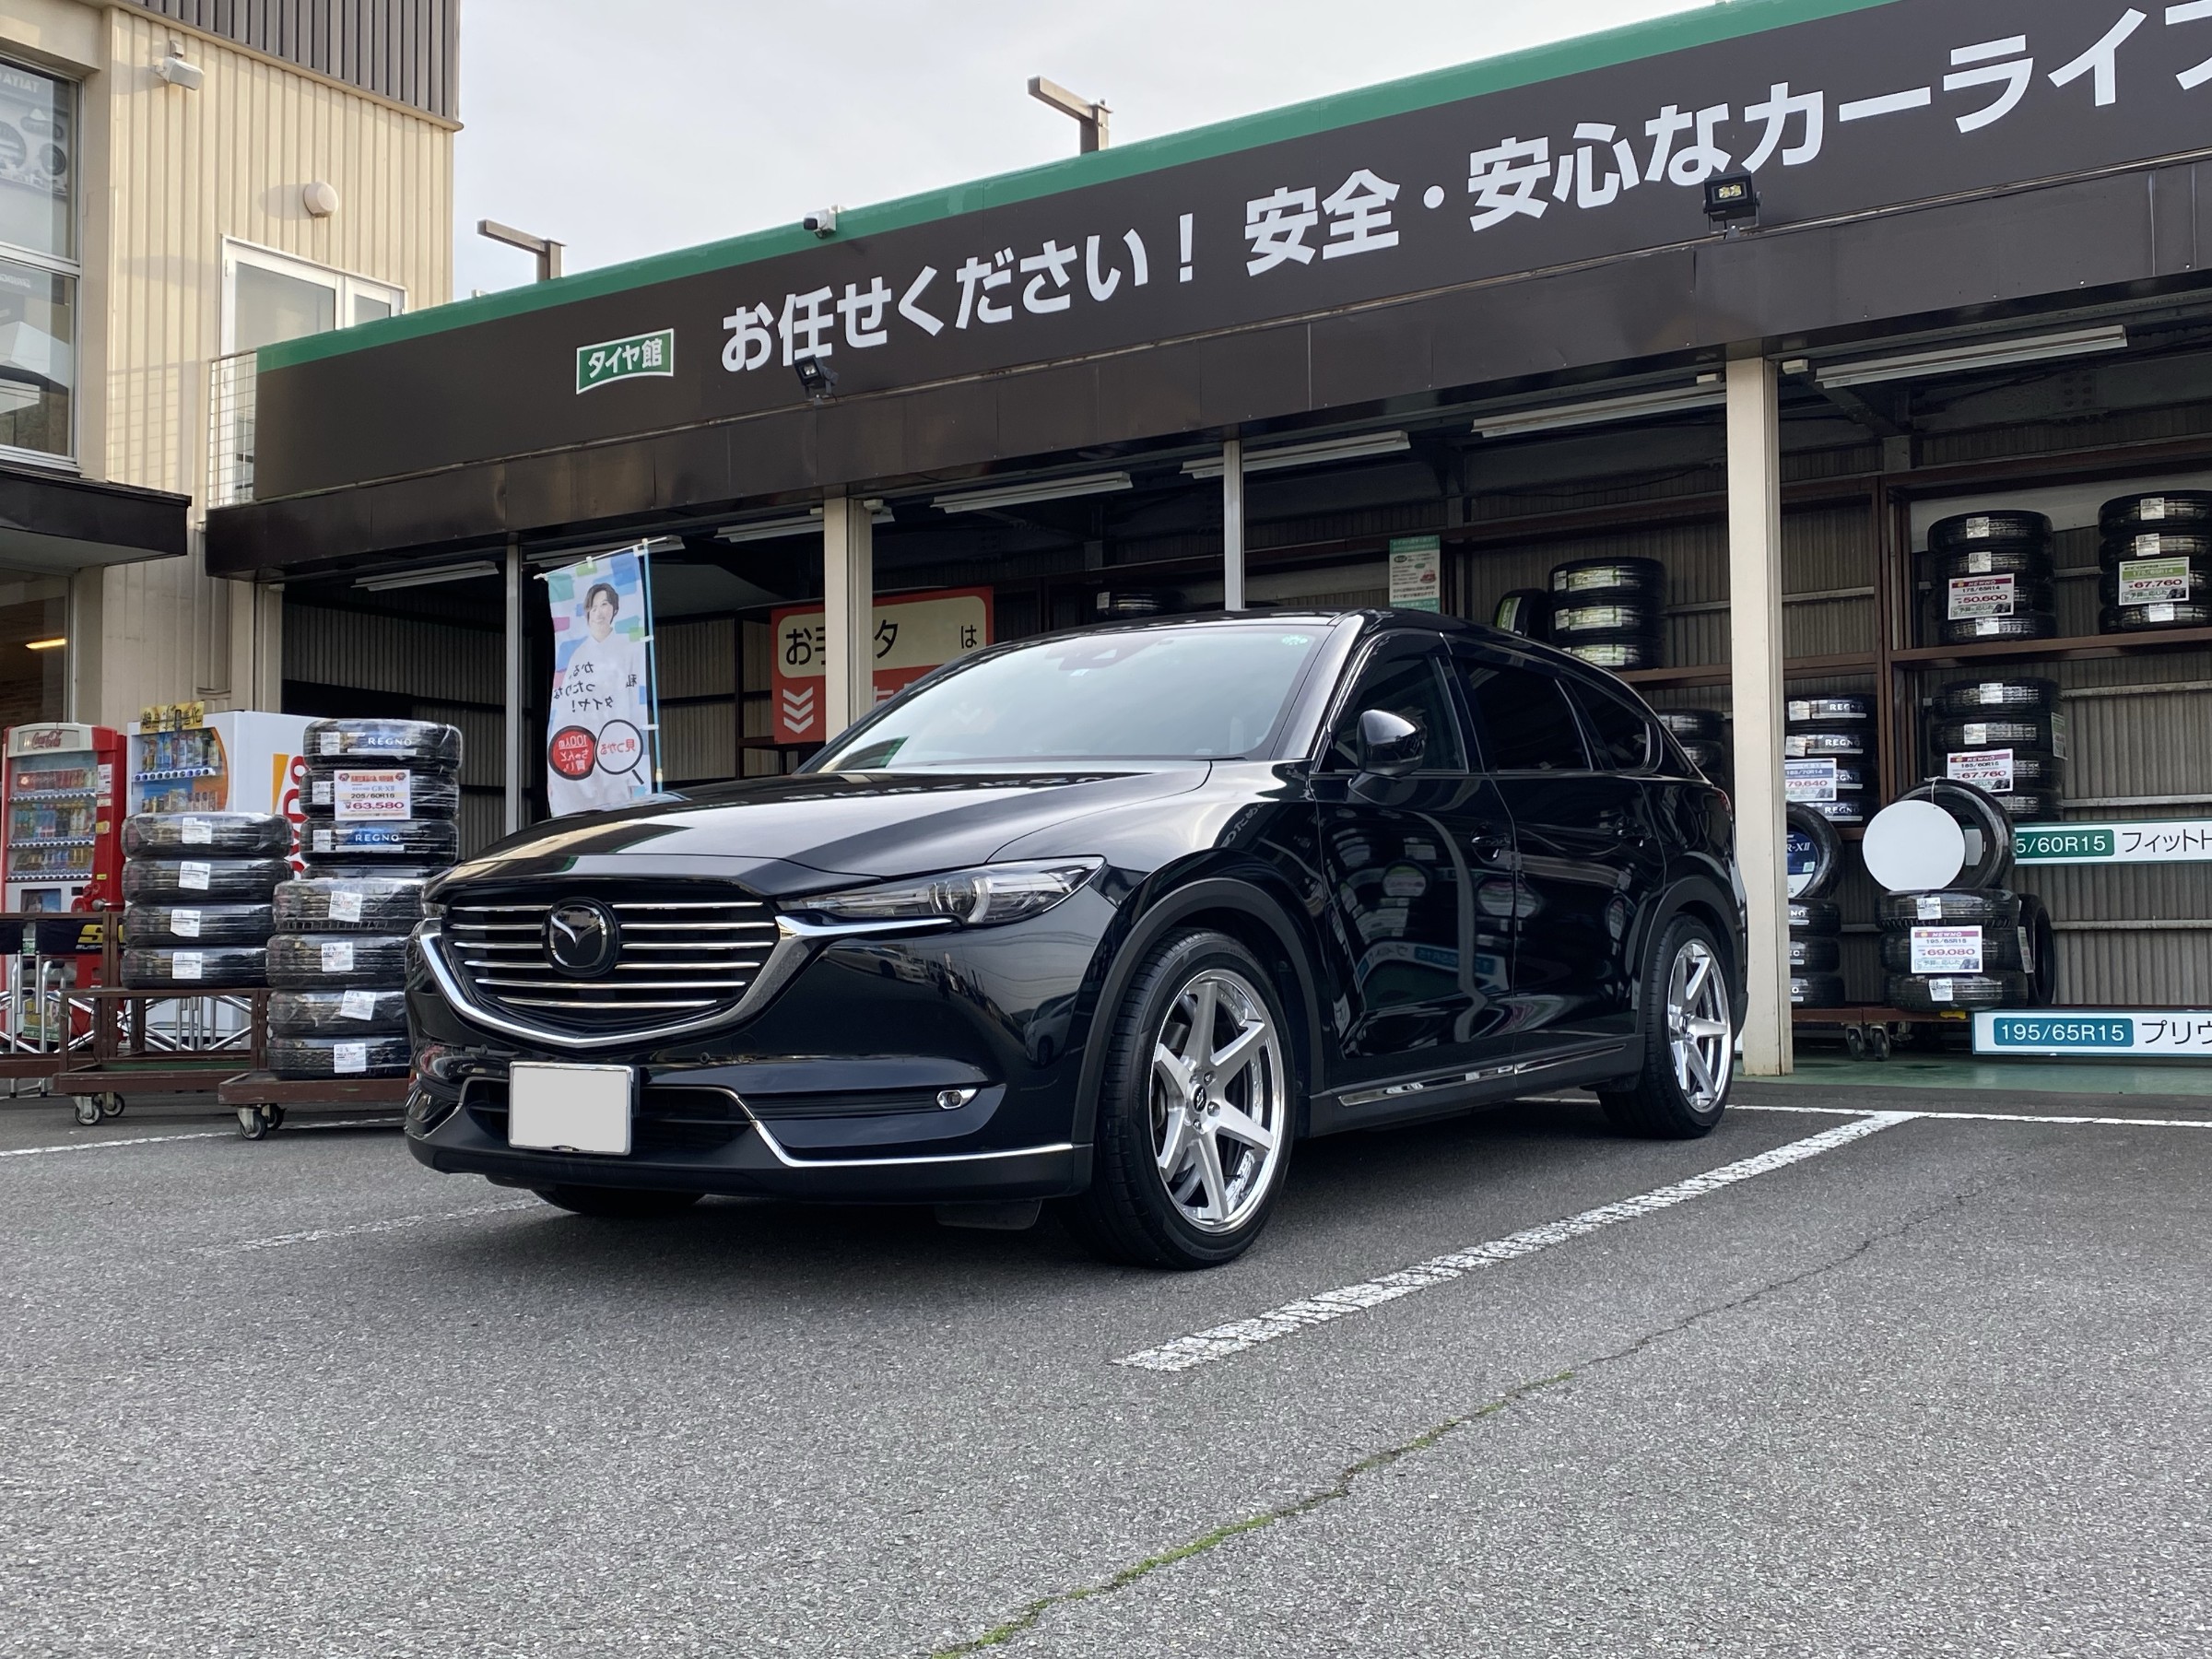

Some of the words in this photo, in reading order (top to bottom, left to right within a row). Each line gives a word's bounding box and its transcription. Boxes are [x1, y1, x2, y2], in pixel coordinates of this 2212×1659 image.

[588, 338, 663, 379] タイヤ館
[368, 737, 412, 746] REGNO
[355, 834, 400, 842] REGNO
[2001, 1024, 2124, 1041] 195/65R15
